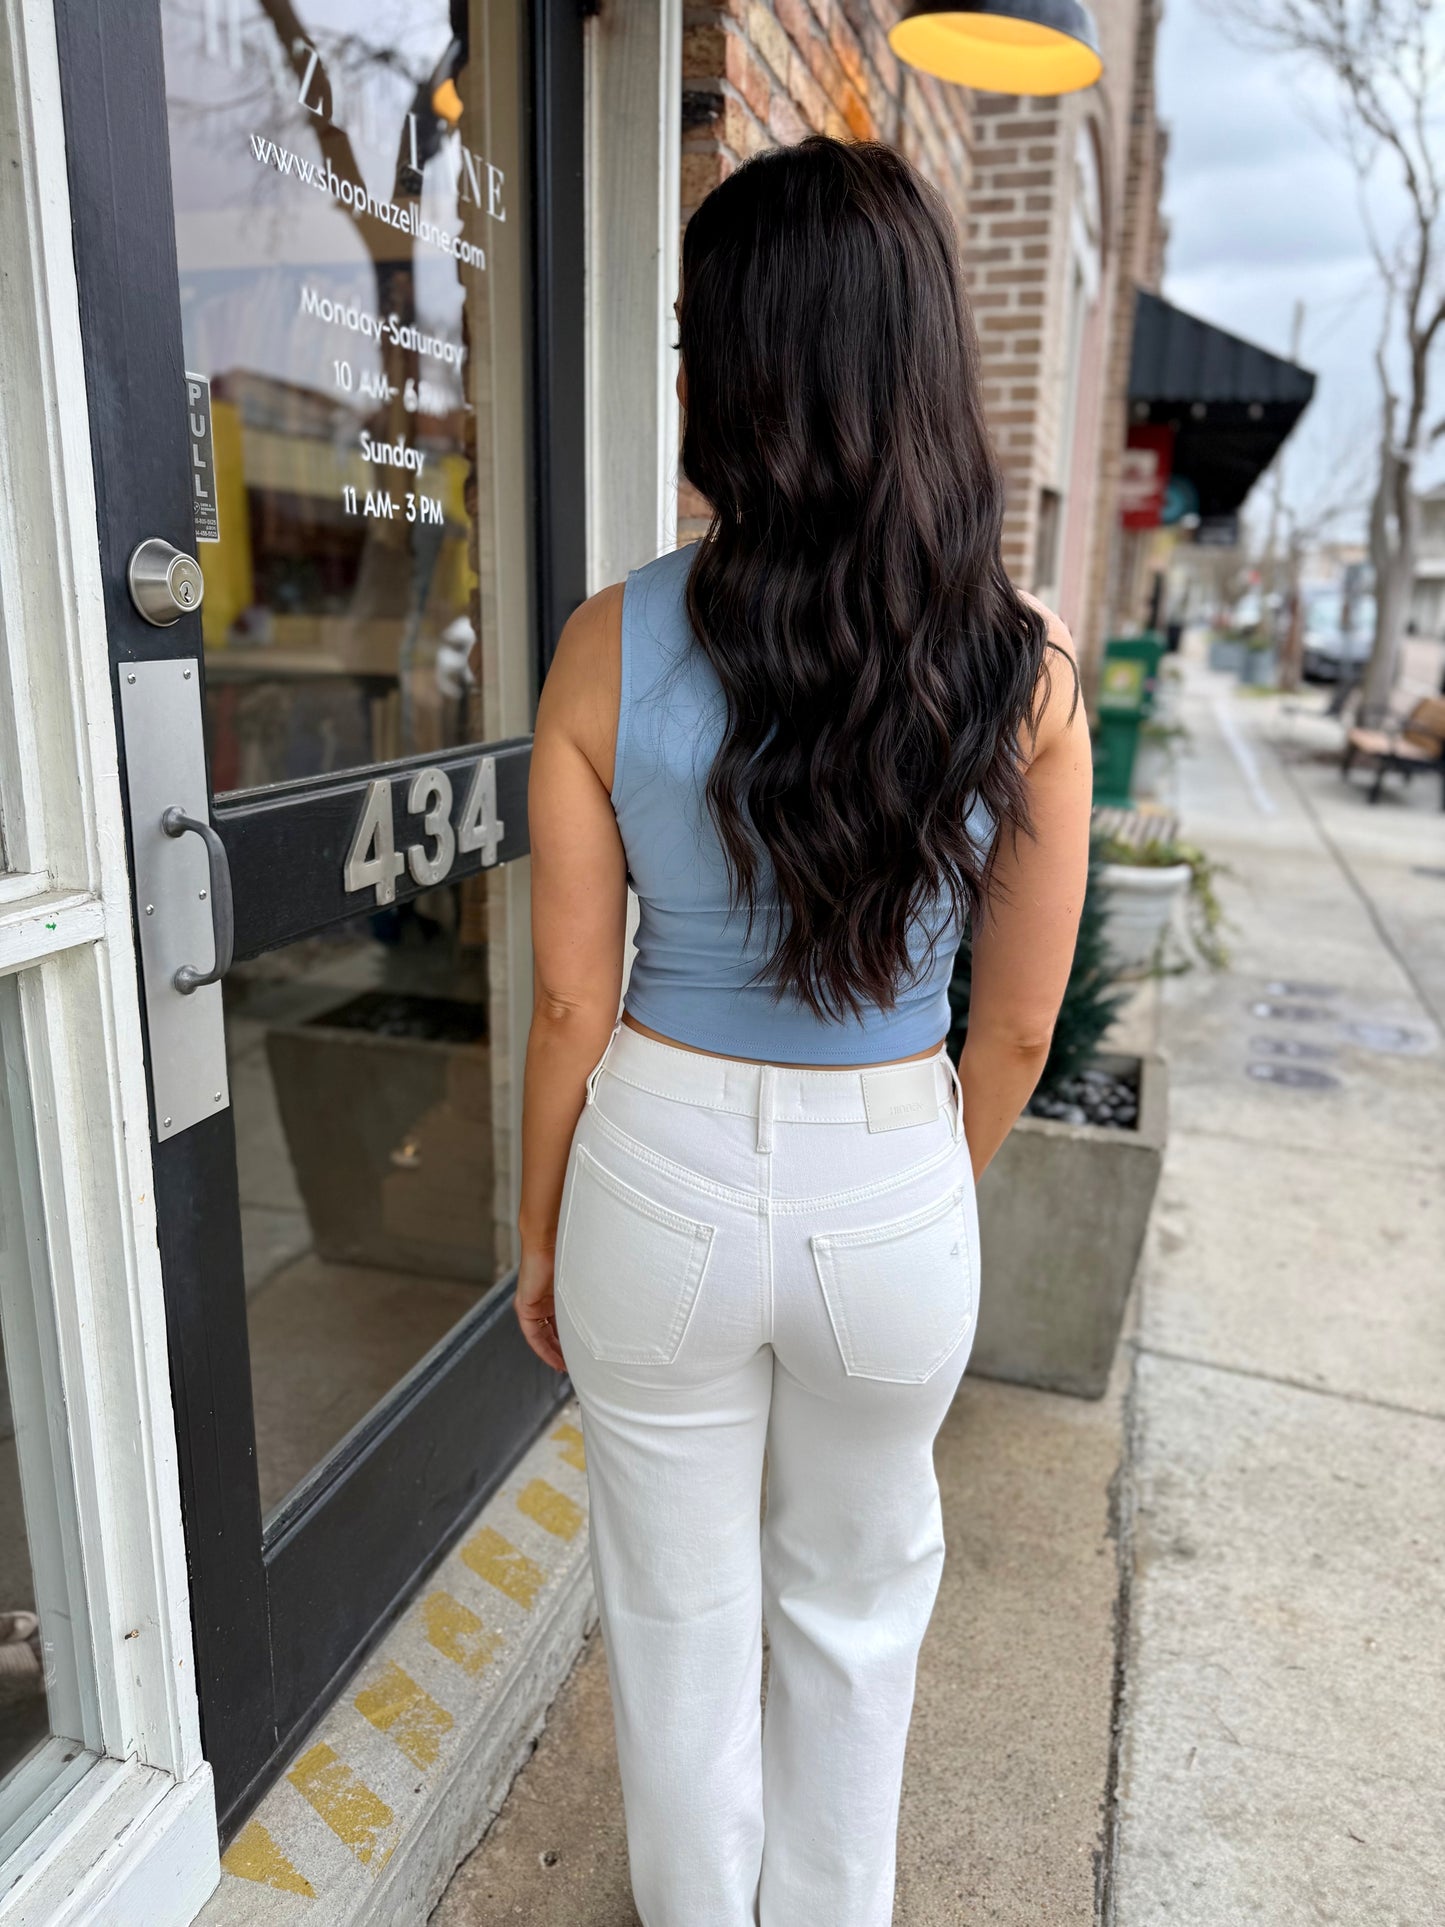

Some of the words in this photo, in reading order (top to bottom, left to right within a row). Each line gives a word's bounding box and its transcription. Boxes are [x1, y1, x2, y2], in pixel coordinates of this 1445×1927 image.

[407, 112, 506, 222] LNE
[333, 360, 352, 392] 10
[188, 382, 208, 498] PULL
[359, 430, 424, 476] Sunday
[342, 486, 358, 515] 11
[406, 493, 416, 522] 3
[421, 497, 444, 525] PM
[344, 756, 505, 906] 434
